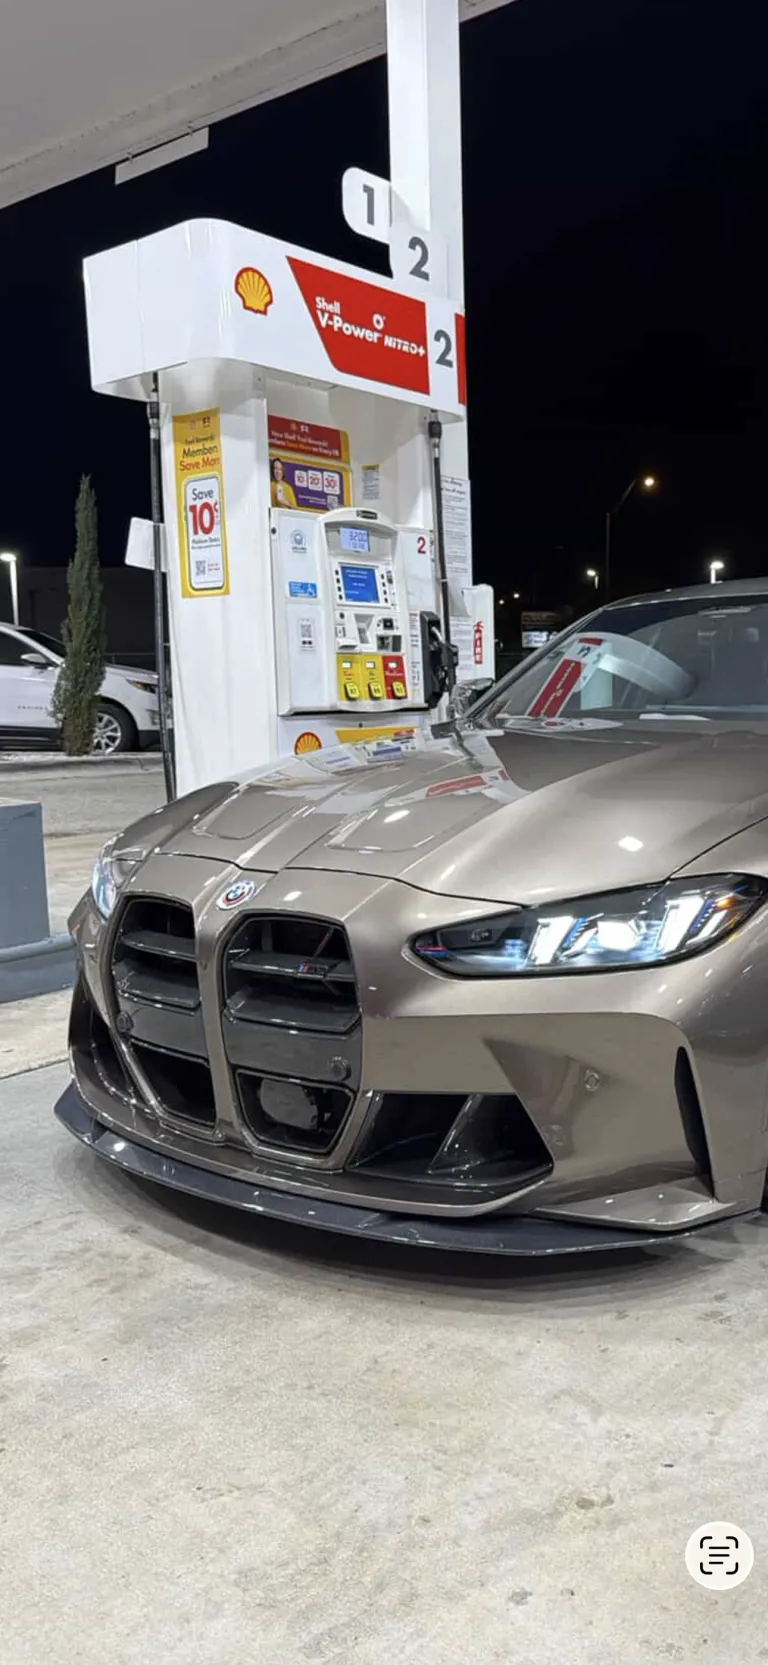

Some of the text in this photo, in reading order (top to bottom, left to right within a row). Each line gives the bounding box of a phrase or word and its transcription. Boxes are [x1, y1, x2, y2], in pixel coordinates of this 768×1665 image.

[362, 184, 375, 226] 1
[408, 236, 430, 282] 2
[315, 296, 341, 314] Shell
[316, 310, 380, 343] V-Power
[433, 328, 454, 369] 2
[179, 459, 201, 472] Save
[192, 488, 214, 501] Save
[417, 536, 426, 555] 2
